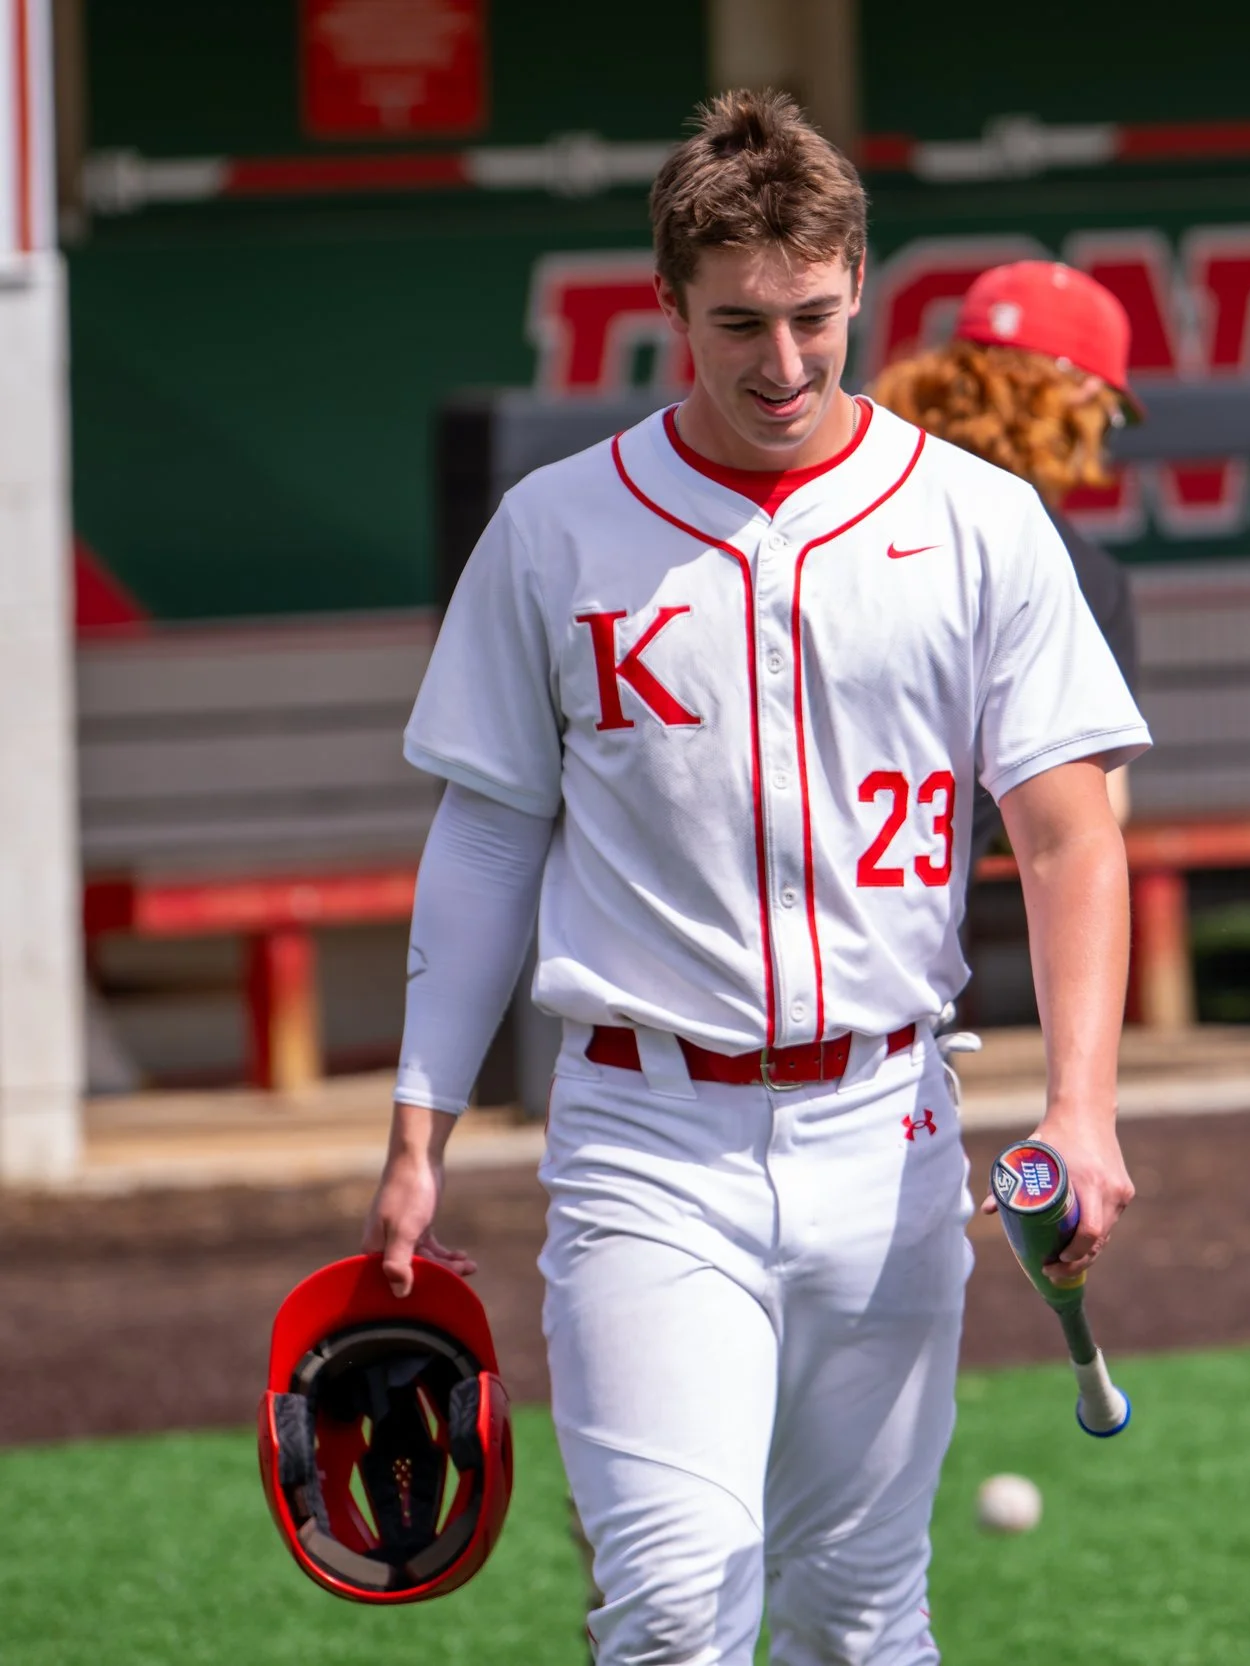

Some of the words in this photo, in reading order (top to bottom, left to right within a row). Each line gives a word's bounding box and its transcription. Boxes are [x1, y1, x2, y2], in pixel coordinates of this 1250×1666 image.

[574, 603, 704, 733] K
[856, 770, 956, 887] 23
[1021, 1161, 1041, 1196] SELECT
[1035, 1163, 1053, 1189] PWR
